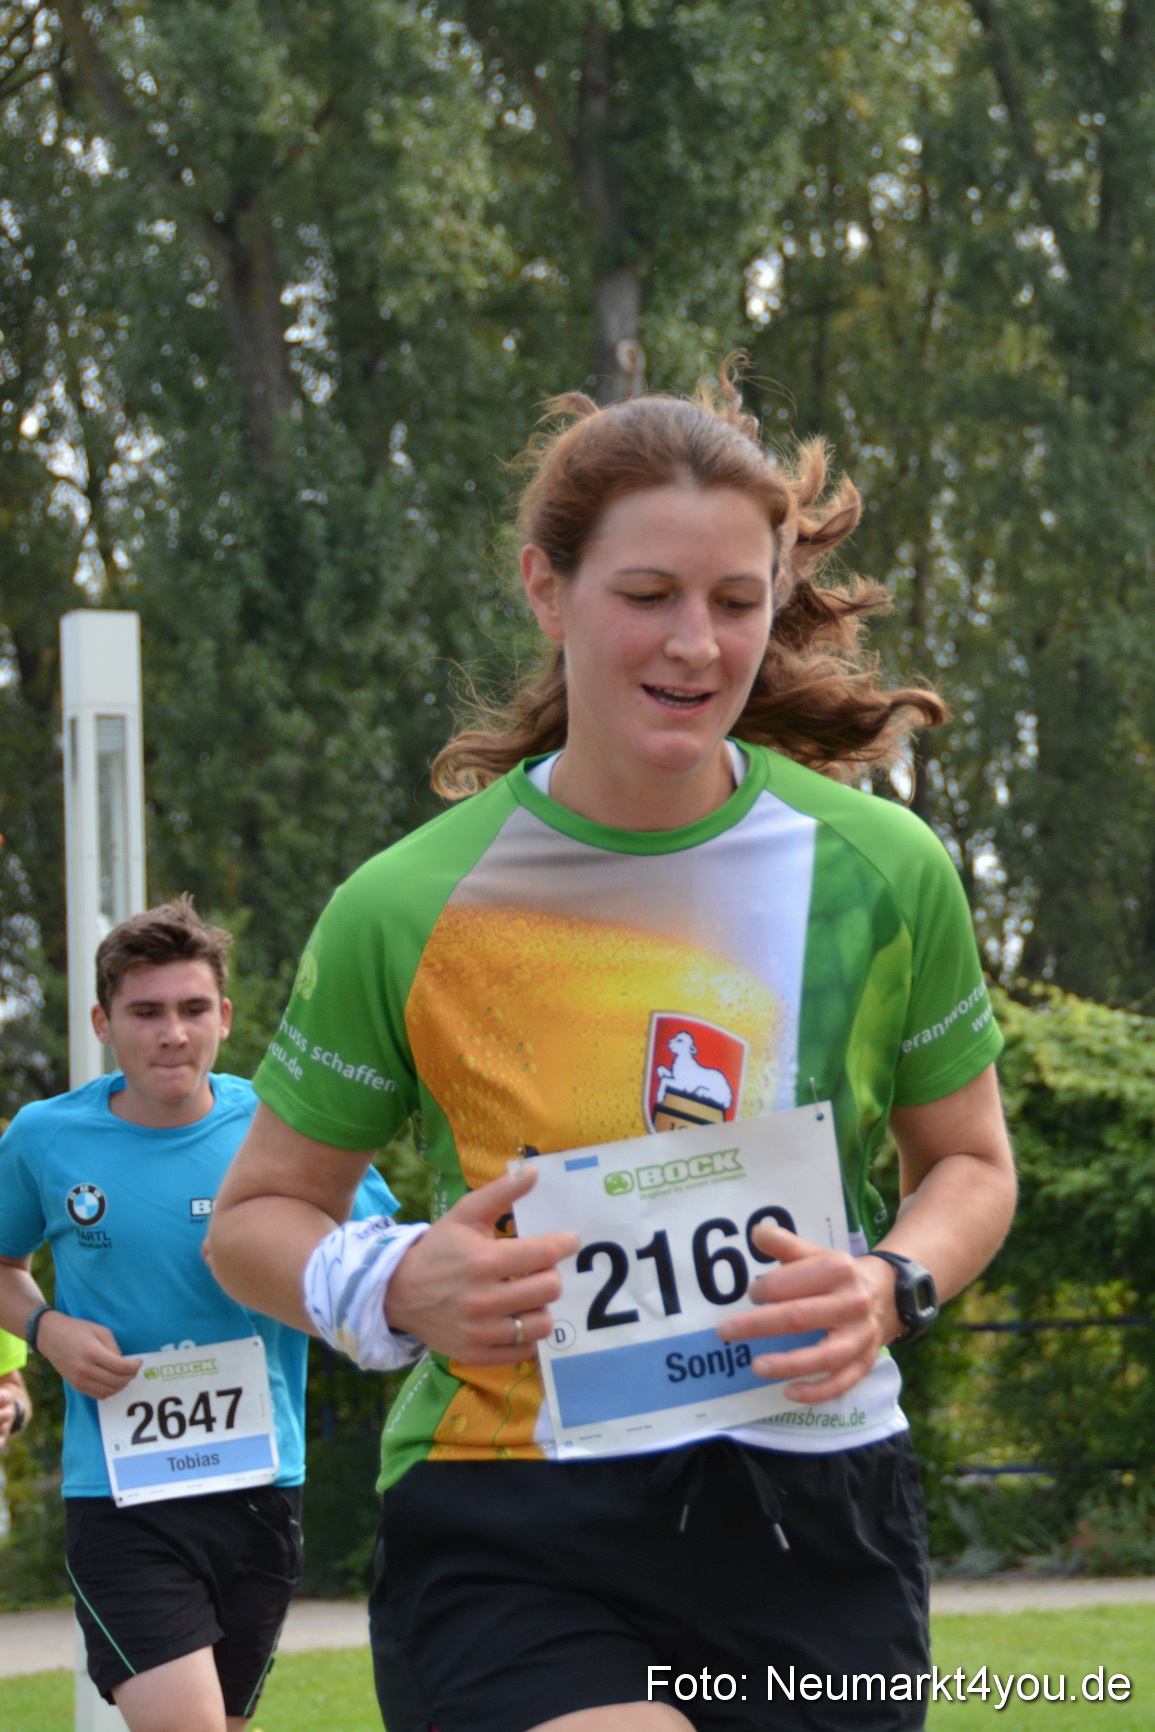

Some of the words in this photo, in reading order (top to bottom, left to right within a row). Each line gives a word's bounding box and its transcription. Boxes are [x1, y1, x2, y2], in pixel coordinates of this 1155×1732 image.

[310, 1045, 397, 1093] schaffen
[635, 1147, 744, 1192] BOCK
[68, 1184, 103, 1201] BMW
[191, 1198, 217, 1216] B
[575, 1205, 798, 1332] 2169
[554, 1328, 567, 1344] D
[160, 1358, 218, 1378] BOCK
[665, 1341, 752, 1383] Sonja
[126, 1387, 243, 1446] 2647
[166, 1453, 221, 1472] Tobias
